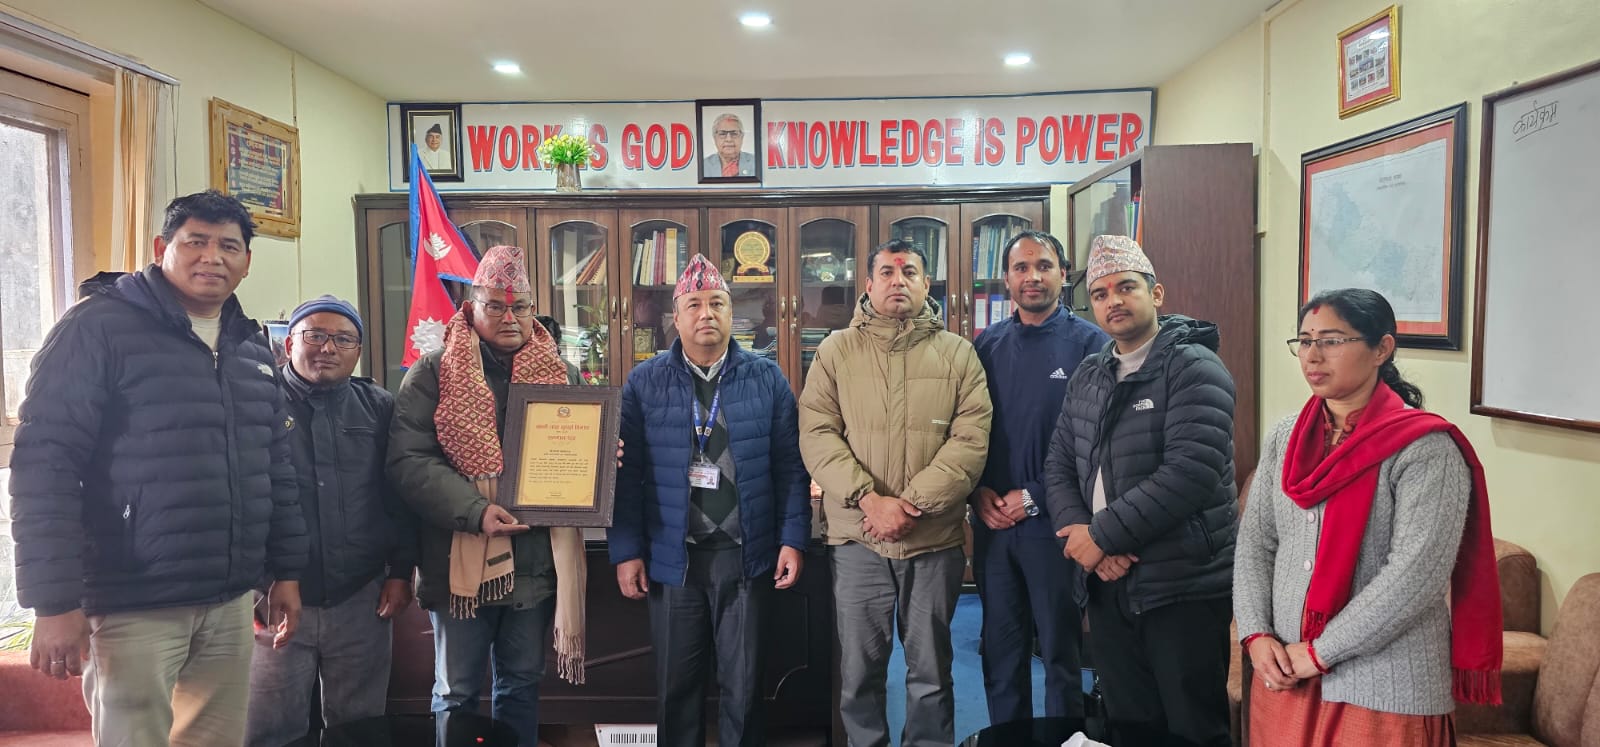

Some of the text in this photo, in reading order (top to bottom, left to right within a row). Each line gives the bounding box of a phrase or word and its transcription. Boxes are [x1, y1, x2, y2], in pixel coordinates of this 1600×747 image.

[577, 123, 608, 171] S
[621, 123, 694, 171] GOD
[767, 112, 1144, 169] KNOWLEDGE IS POWER
